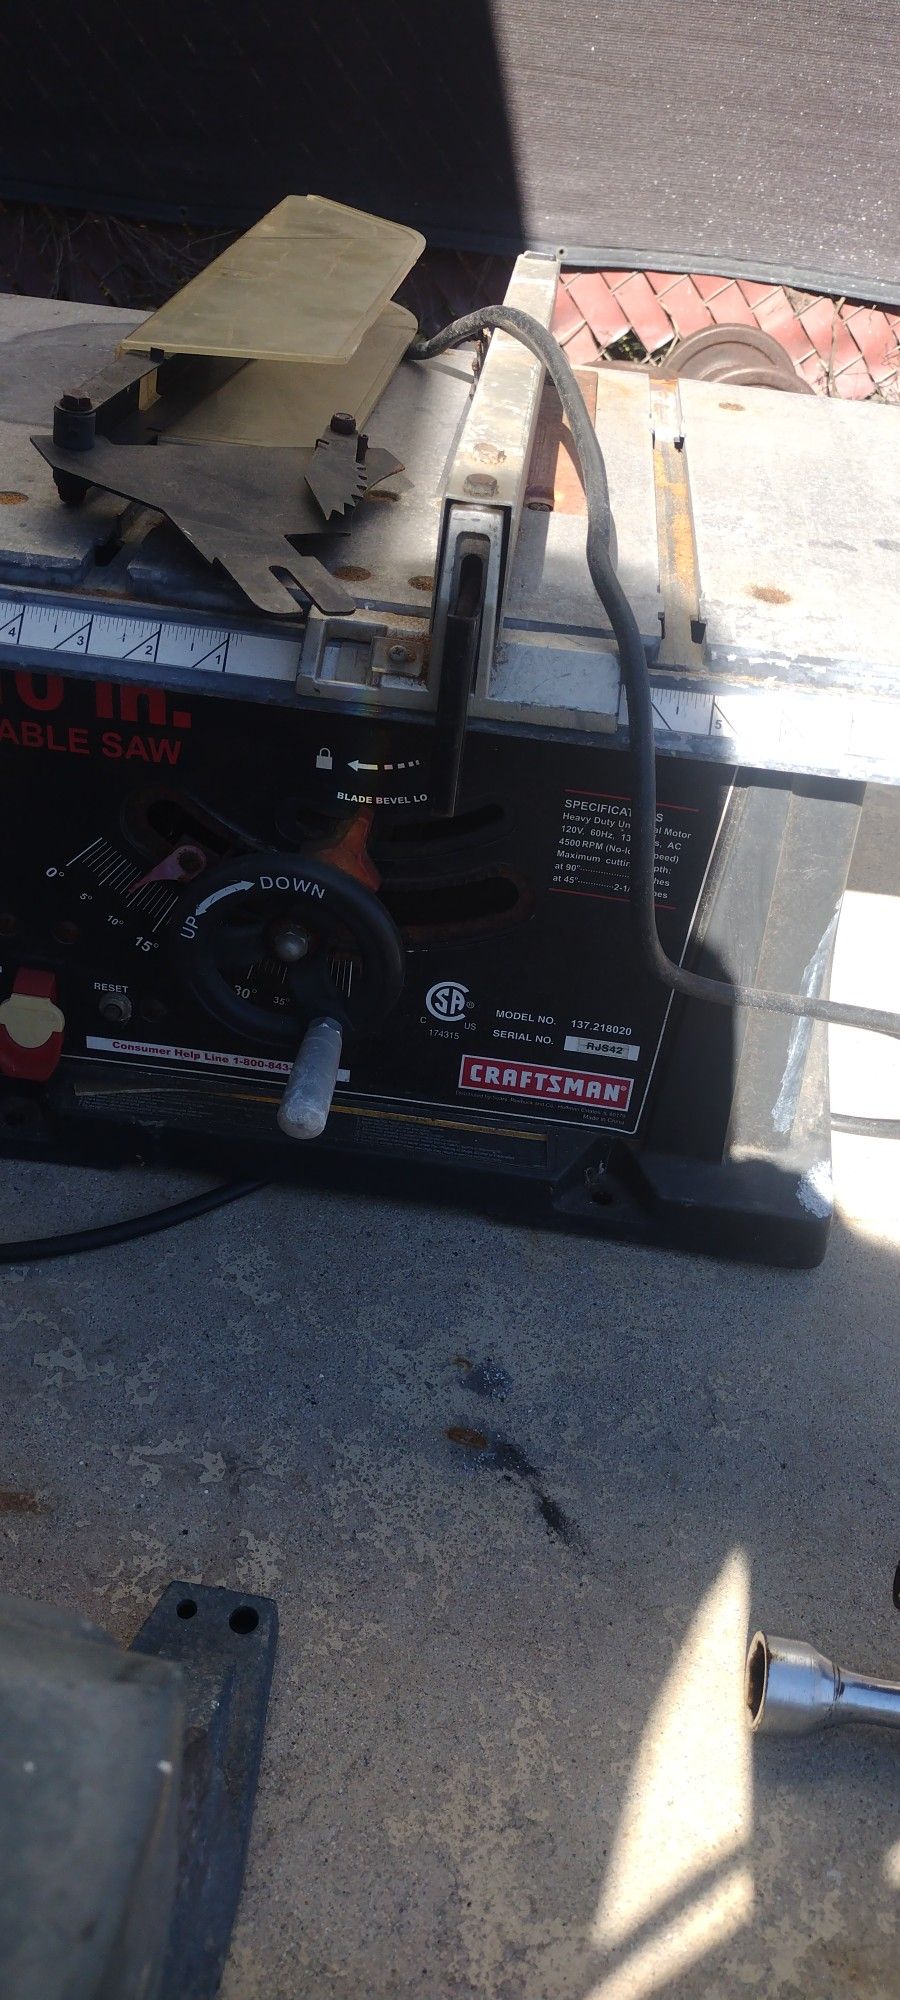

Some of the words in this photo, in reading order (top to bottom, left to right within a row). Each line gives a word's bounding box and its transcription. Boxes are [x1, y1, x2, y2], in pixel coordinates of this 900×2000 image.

[8, 627, 16, 638] 4
[77, 635, 84, 646] 3
[144, 644, 154, 656] 2
[215, 654, 222, 664] 1
[715, 719, 722, 729] 5
[0, 718, 91, 755] ABLE
[101, 730, 183, 765] SAW
[336, 791, 373, 805] BLADE
[375, 796, 411, 805] BEVEL
[413, 793, 428, 803] LO
[564, 799, 664, 822] SPECIFICATS
[562, 812, 592, 825] Heavy
[594, 816, 616, 828] Duty
[664, 828, 692, 839] Motor
[558, 837, 581, 848] 4500
[582, 840, 604, 851] RPM
[654, 853, 680, 865] peed)
[667, 842, 682, 851] AC
[554, 862, 564, 870] at
[556, 850, 601, 863] Maximum
[654, 865, 672, 876] pth:
[259, 875, 326, 900] DOWN
[552, 874, 562, 883] at
[613, 883, 631, 893] 2-1/
[106, 914, 125, 926] 10°
[179, 915, 199, 940] UP
[134, 936, 160, 952] 15°
[93, 982, 129, 994] RESET
[234, 984, 258, 999] 30°
[464, 1021, 477, 1032] US
[495, 1009, 535, 1023] MODEL
[538, 1014, 557, 1026] NO.
[570, 1019, 633, 1037] 137.218020
[428, 1028, 460, 1041] 174315
[492, 1029, 533, 1043] SERIAL
[535, 1034, 555, 1046] NO.
[586, 1041, 624, 1056] RJS42
[112, 1040, 172, 1057] Consumer
[174, 1047, 201, 1062] Help
[204, 1052, 230, 1065] Line
[232, 1057, 294, 1073] 1-800-843-
